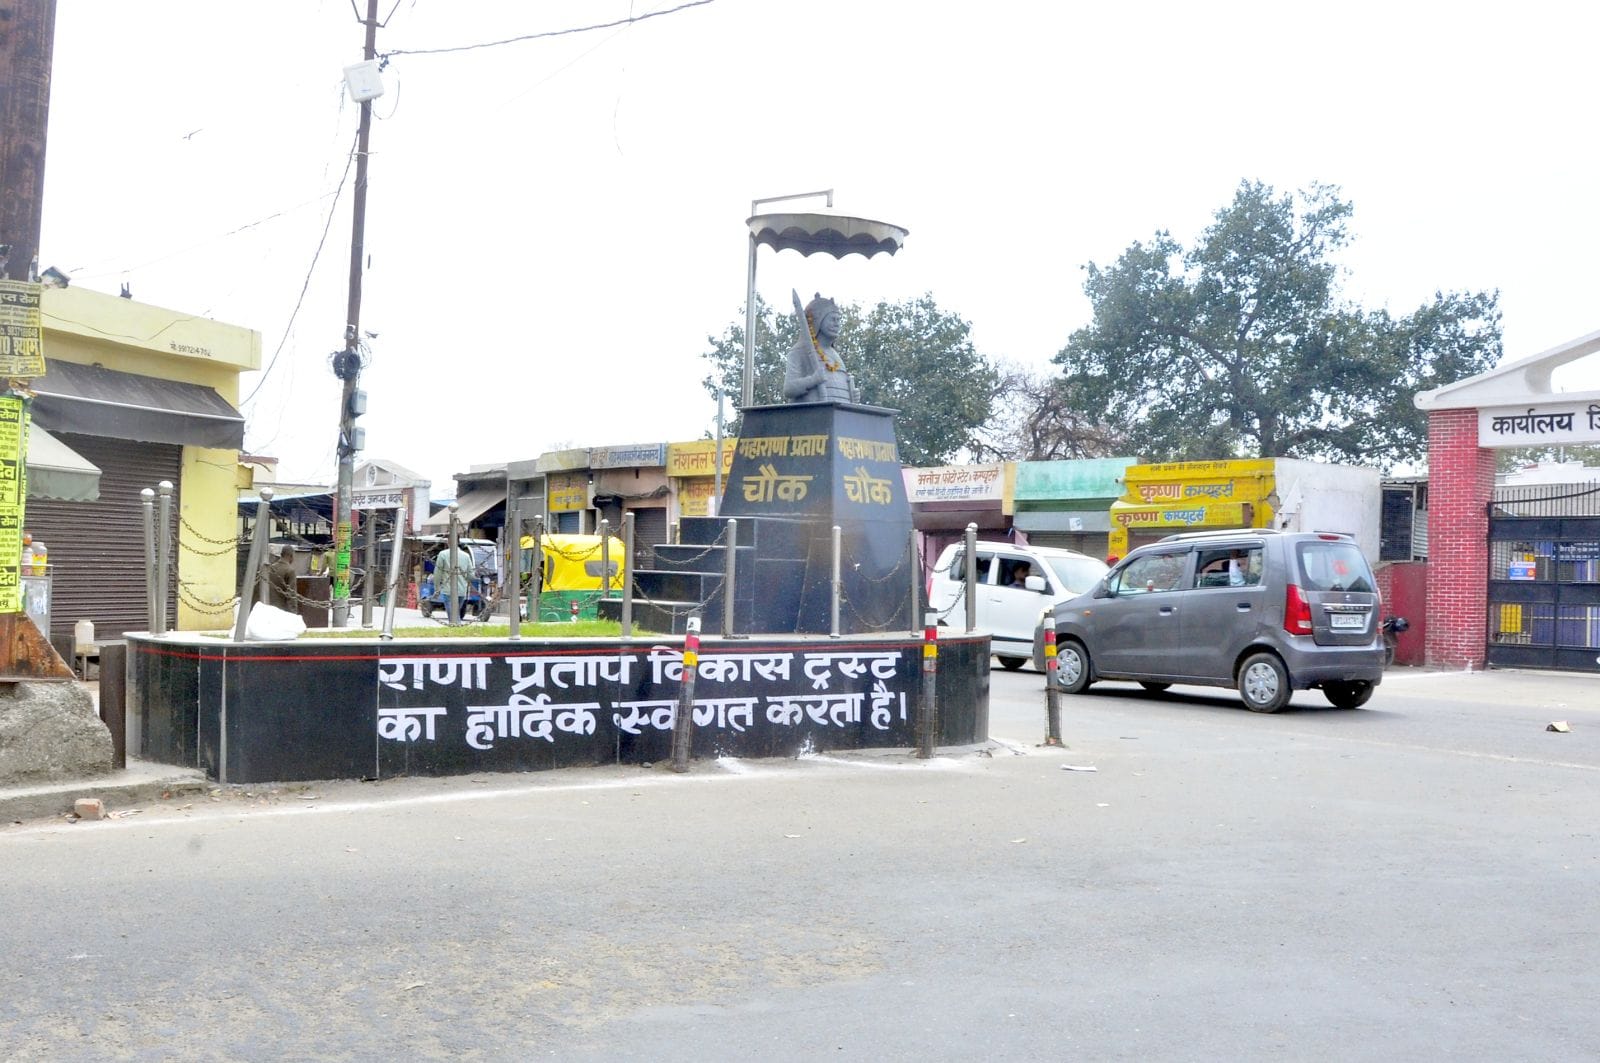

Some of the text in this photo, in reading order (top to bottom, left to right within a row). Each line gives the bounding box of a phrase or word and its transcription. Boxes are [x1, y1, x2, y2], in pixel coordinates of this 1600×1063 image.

[1492, 408, 1575, 435] कार्यालय
[739, 434, 829, 459] महाराणा प्रताप
[837, 436, 896, 462] महाराणा प्रताप
[742, 463, 813, 503] चौक
[843, 465, 893, 505] चौक
[918, 471, 940, 485] मनोज
[1140, 484, 1182, 503] कृष्णा
[1115, 511, 1160, 527] कृष्णा
[378, 645, 902, 694] राणा प्रताप विकास ट्रस्ट
[378, 707, 447, 743] का
[465, 693, 601, 750] हार्दिक
[766, 693, 865, 728] करता
